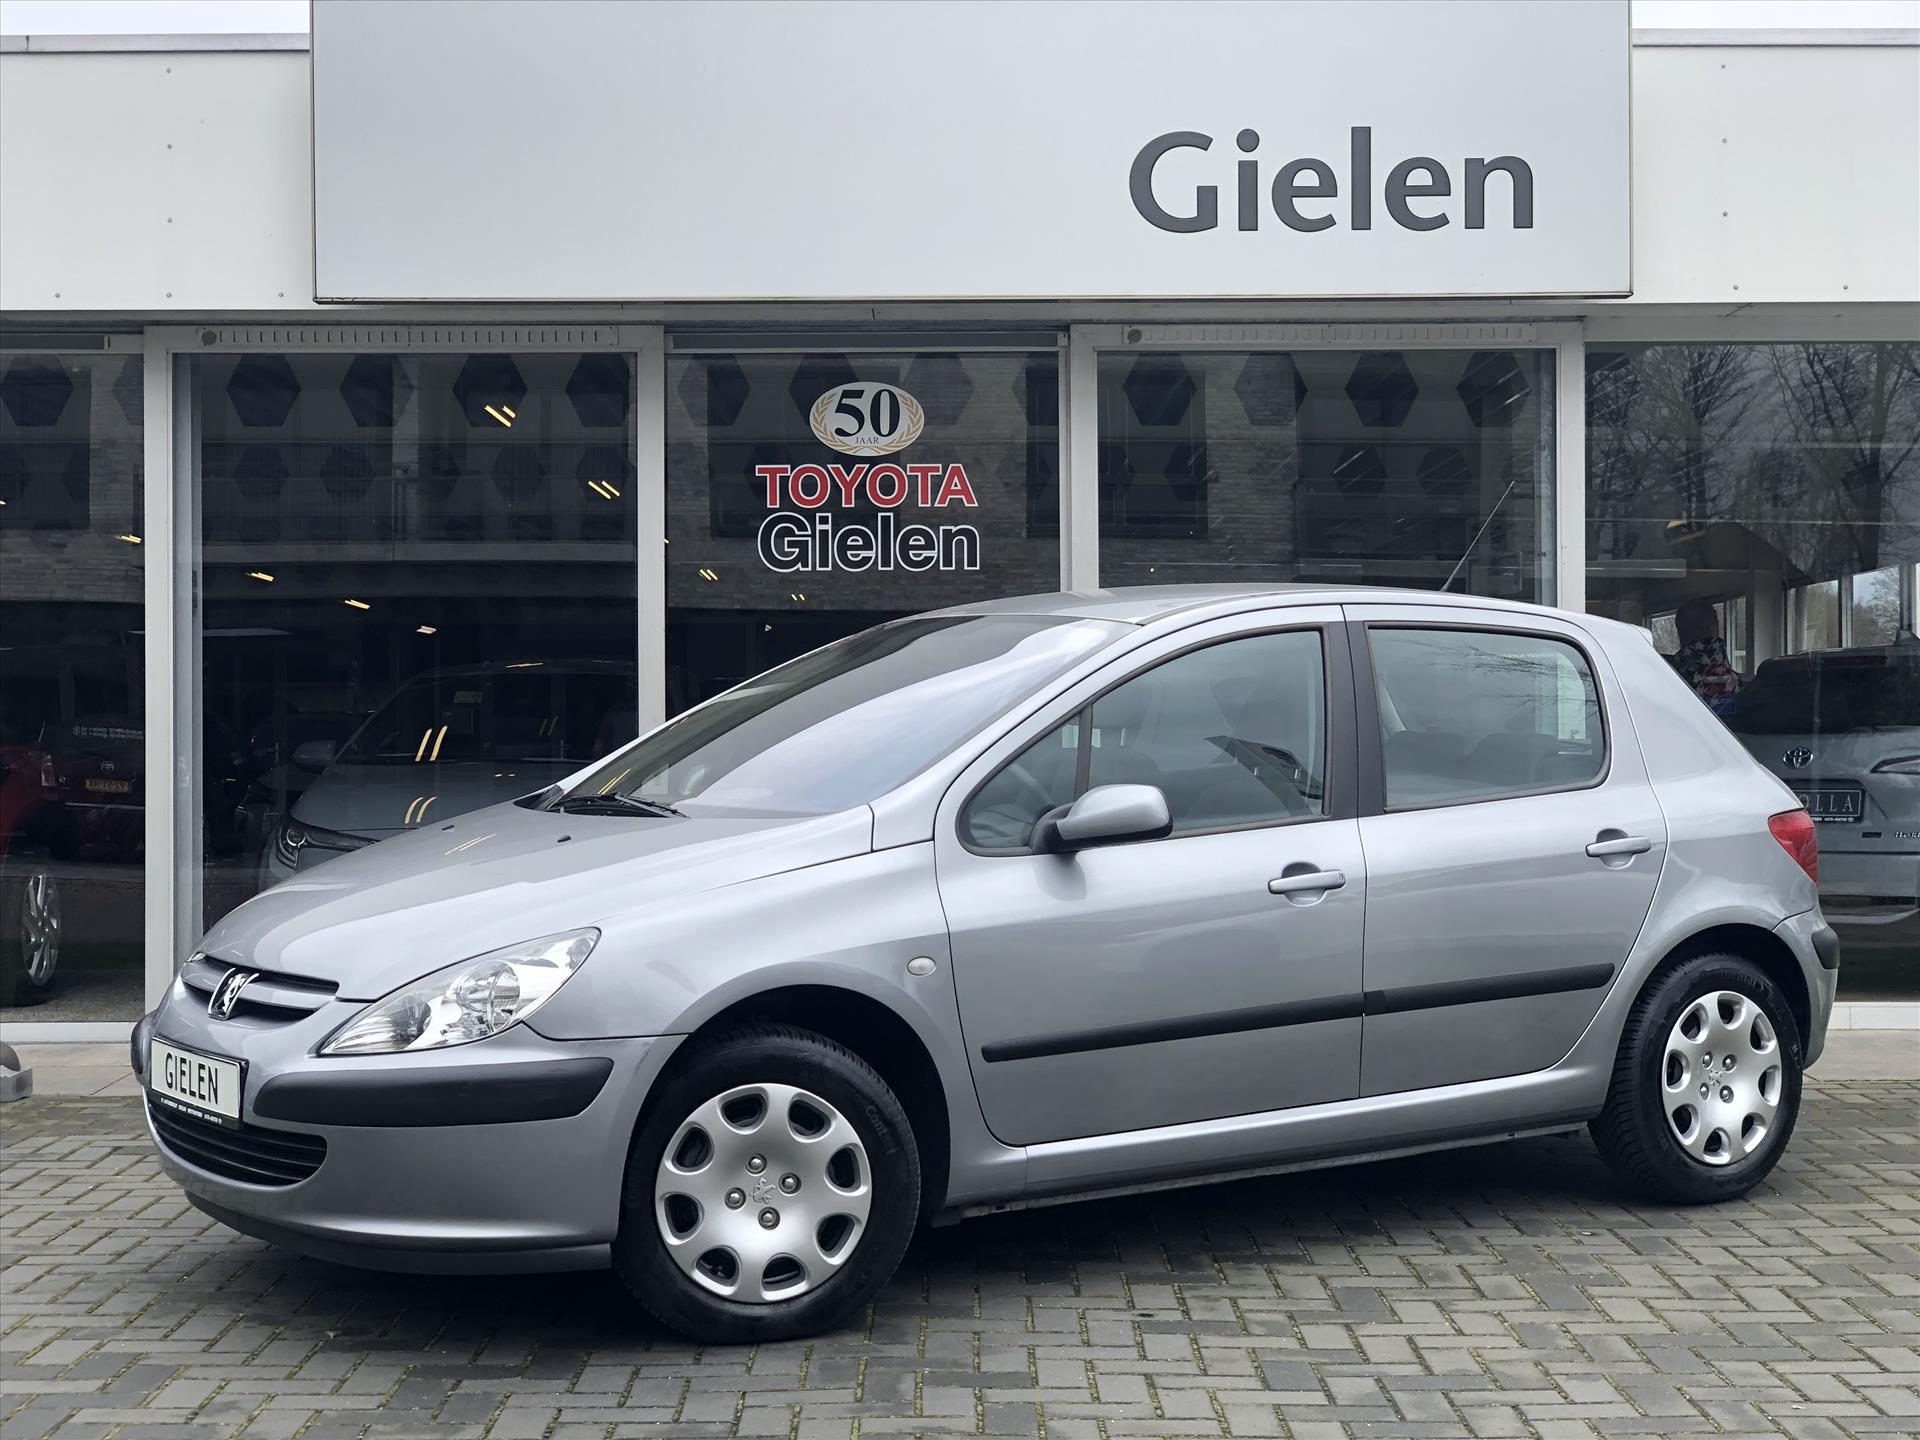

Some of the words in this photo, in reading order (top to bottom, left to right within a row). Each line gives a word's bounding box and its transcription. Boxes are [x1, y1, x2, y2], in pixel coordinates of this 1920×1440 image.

[1128, 126, 1534, 234] Gielen
[834, 388, 901, 438] 50
[854, 436, 879, 445] JAAR
[755, 463, 979, 509] TOYOTA
[757, 511, 980, 573] Gielen
[165, 1052, 218, 1105] GIELEN
